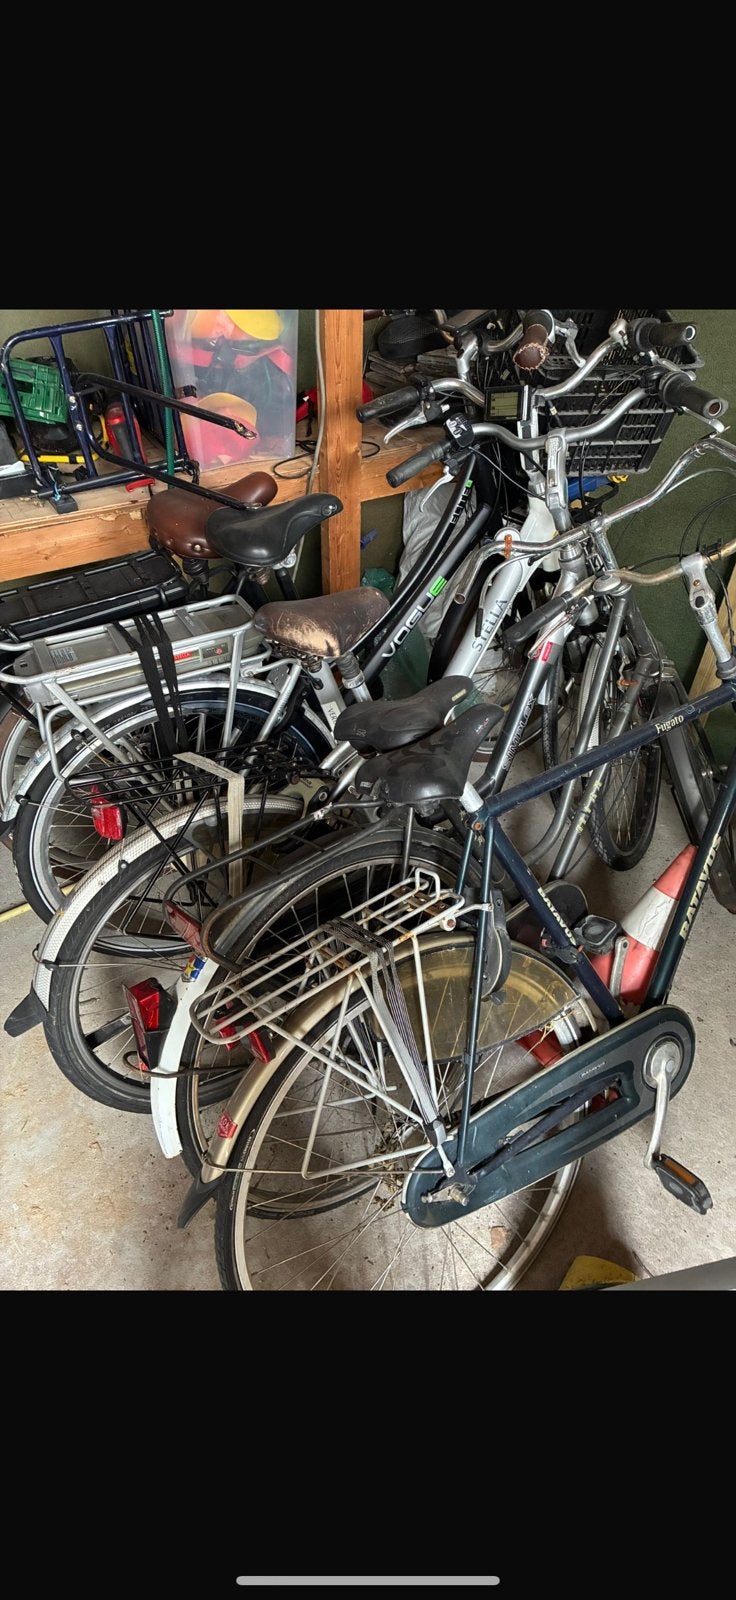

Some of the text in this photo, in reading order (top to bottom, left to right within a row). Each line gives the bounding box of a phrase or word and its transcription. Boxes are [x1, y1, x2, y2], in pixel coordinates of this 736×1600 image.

[450, 486, 470, 525] ELITE
[381, 575, 447, 657] VOGUE
[472, 600, 508, 652] STELLA
[501, 692, 537, 771] SIMPLEX
[655, 714, 685, 734] Fugato
[680, 832, 722, 940] BATAVUS
[537, 887, 577, 946] BATAVUS
